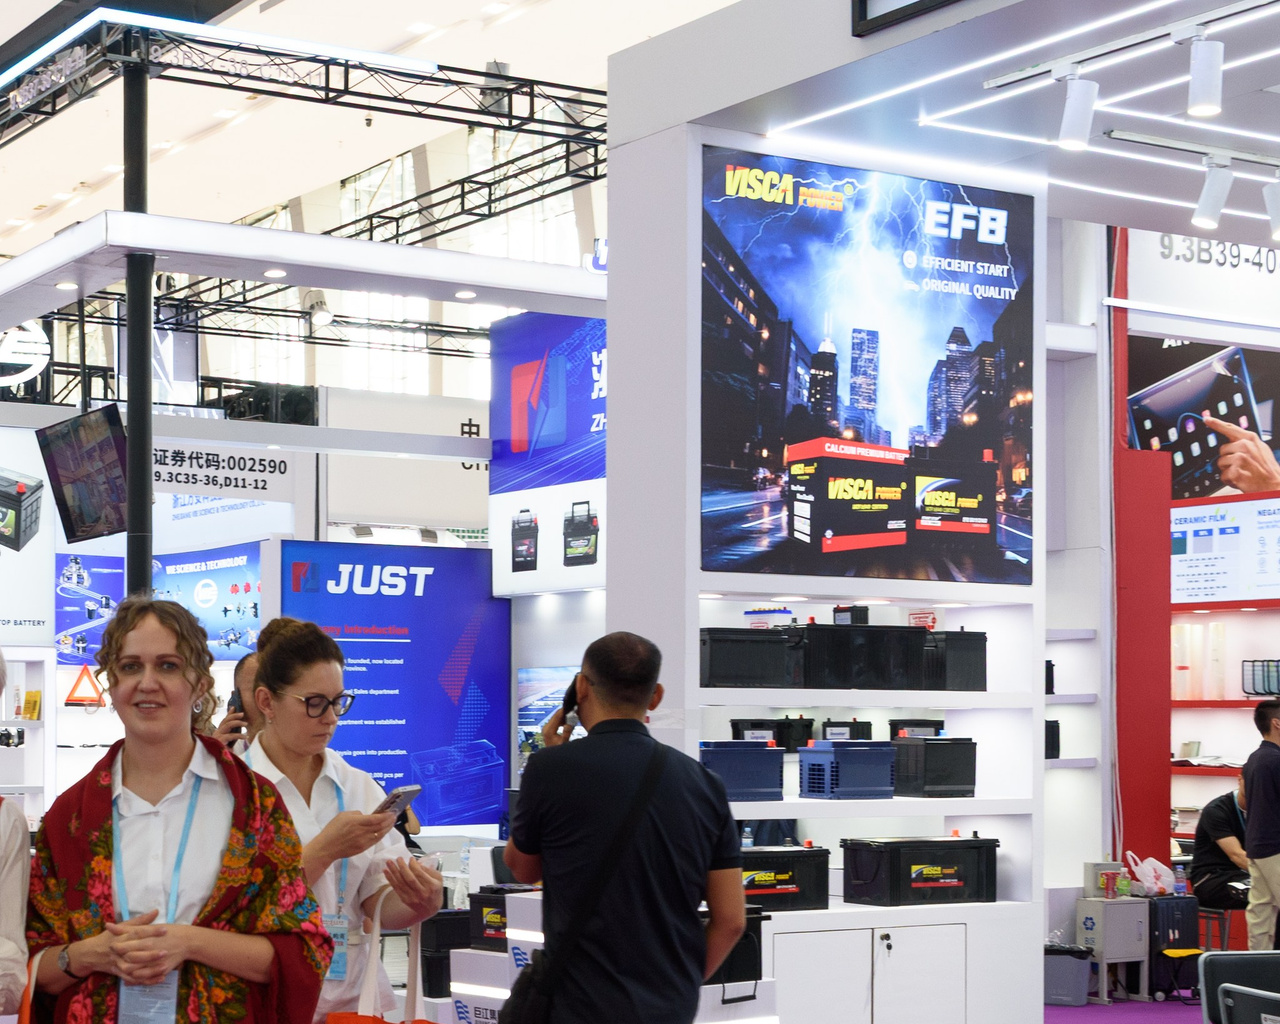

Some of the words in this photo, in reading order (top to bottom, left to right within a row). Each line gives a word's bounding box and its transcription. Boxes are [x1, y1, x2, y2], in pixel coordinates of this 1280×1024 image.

[725, 164, 793, 206] VISCA
[798, 187, 844, 212] POWER
[924, 199, 1008, 246] EFB
[922, 254, 975, 275] EFFICIENT
[976, 262, 1009, 278] START
[922, 278, 972, 297] ORIGINAL
[973, 282, 1017, 301] QUALITY
[825, 442, 857, 455] CALCIUM
[153, 448, 288, 475] 证券代码:002590
[154, 471, 268, 491] 9.3C35-36,D11-12
[828, 477, 873, 500] VISCA
[924, 490, 956, 508] VISCA
[326, 563, 435, 597] JUST
[13, 619, 47, 627] BATTERY
[344, 625, 409, 635] Introduction
[474, 1006, 499, 1021] 巨江集
